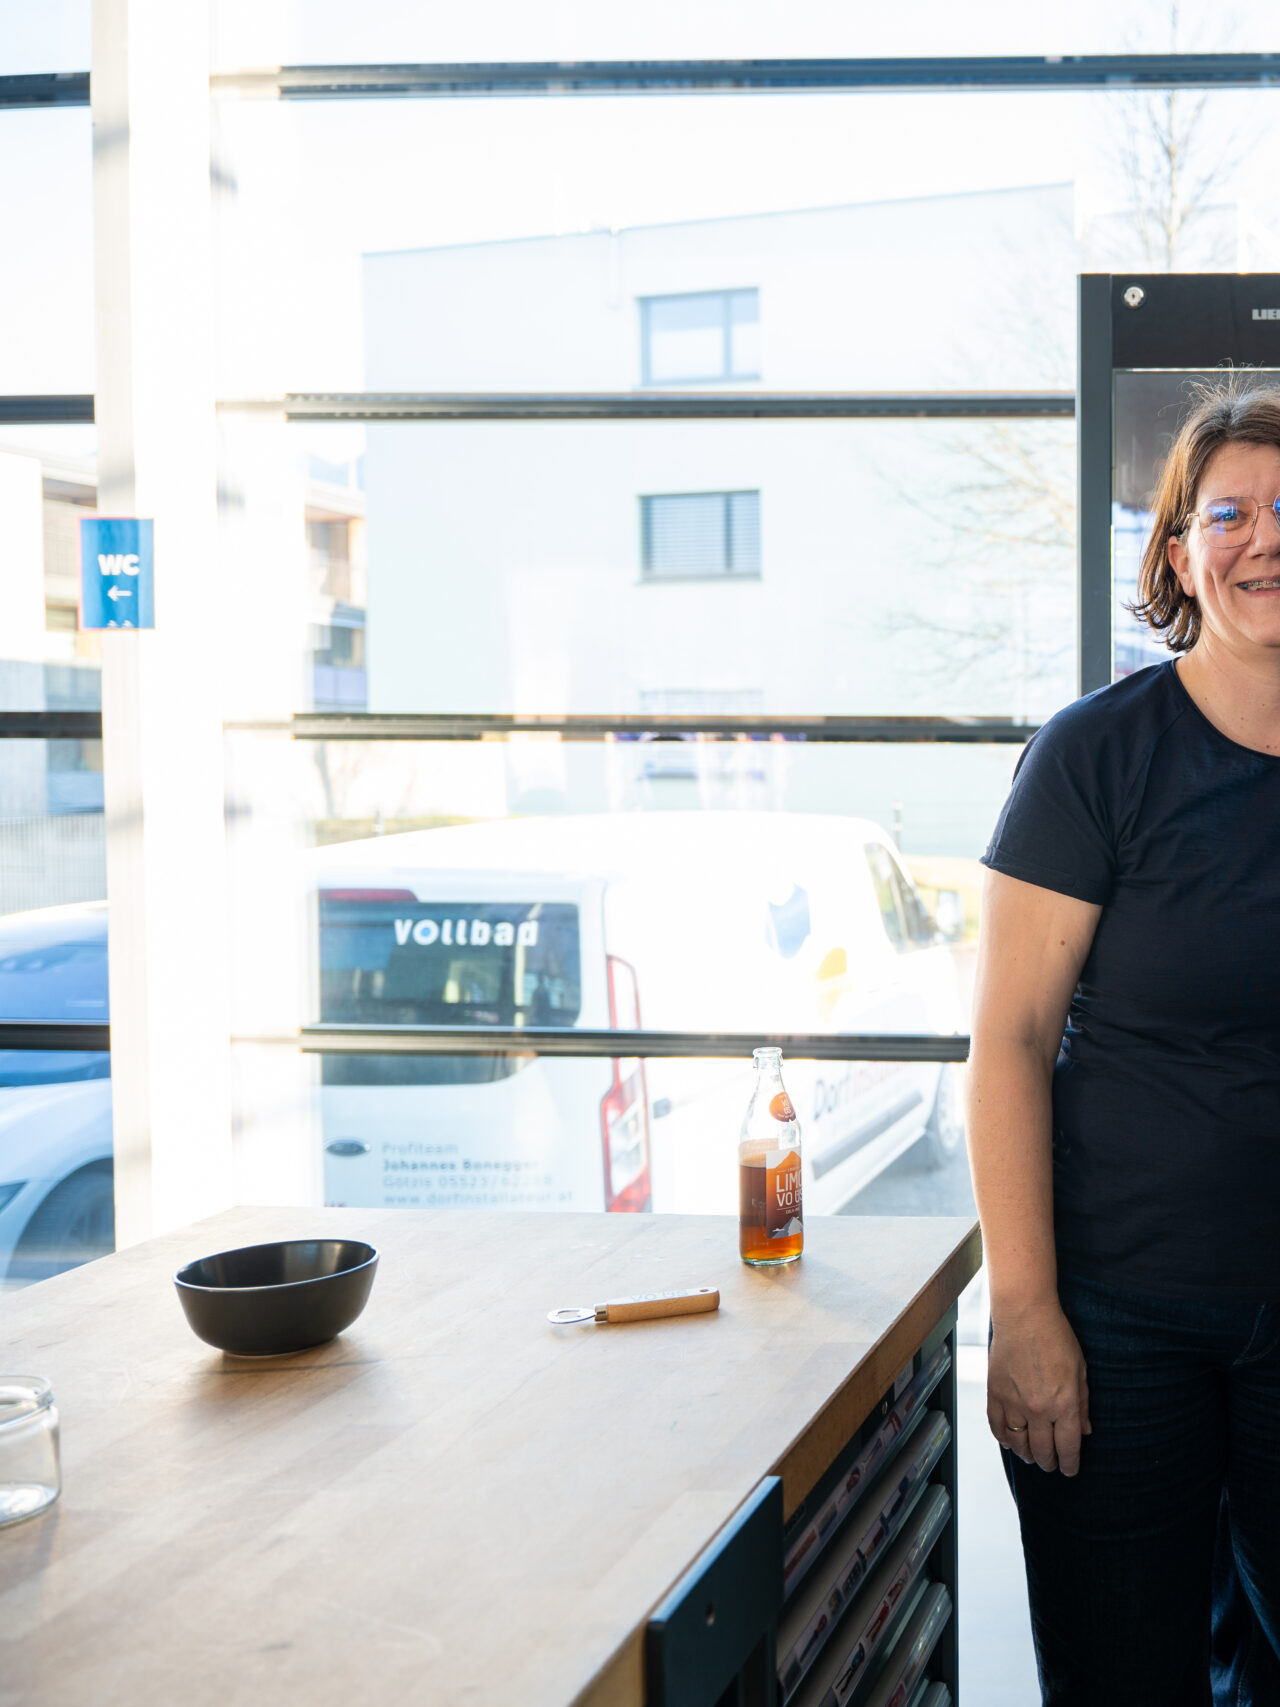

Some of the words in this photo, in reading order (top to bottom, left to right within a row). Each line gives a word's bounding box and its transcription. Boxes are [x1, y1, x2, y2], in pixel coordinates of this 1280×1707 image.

[97, 553, 141, 576] WC
[382, 1159, 456, 1171] Johannes
[776, 1191, 793, 1208] VO
